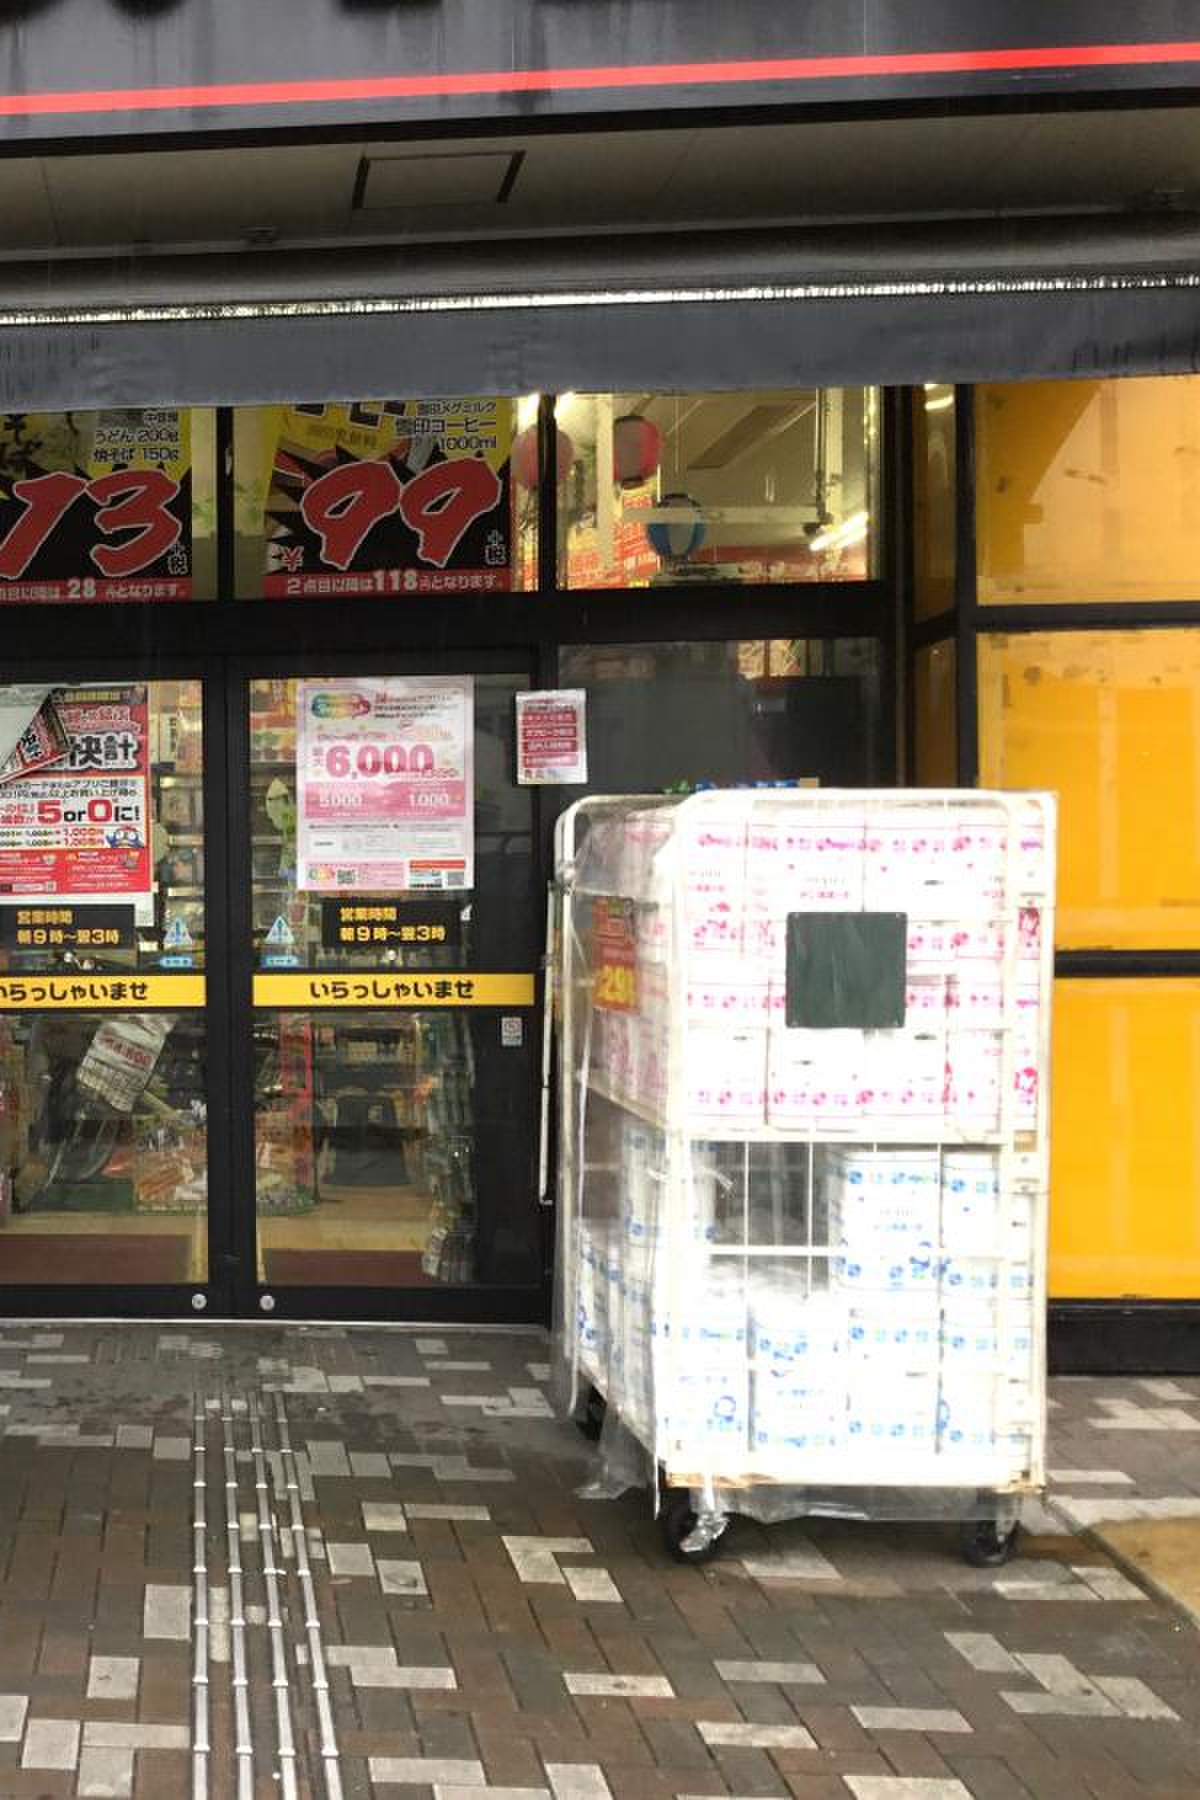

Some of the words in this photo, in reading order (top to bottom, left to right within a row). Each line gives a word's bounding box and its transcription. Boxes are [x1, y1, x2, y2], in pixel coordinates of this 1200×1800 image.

[300, 458, 502, 571] 99
[310, 980, 474, 999] いらっしゃいませ
